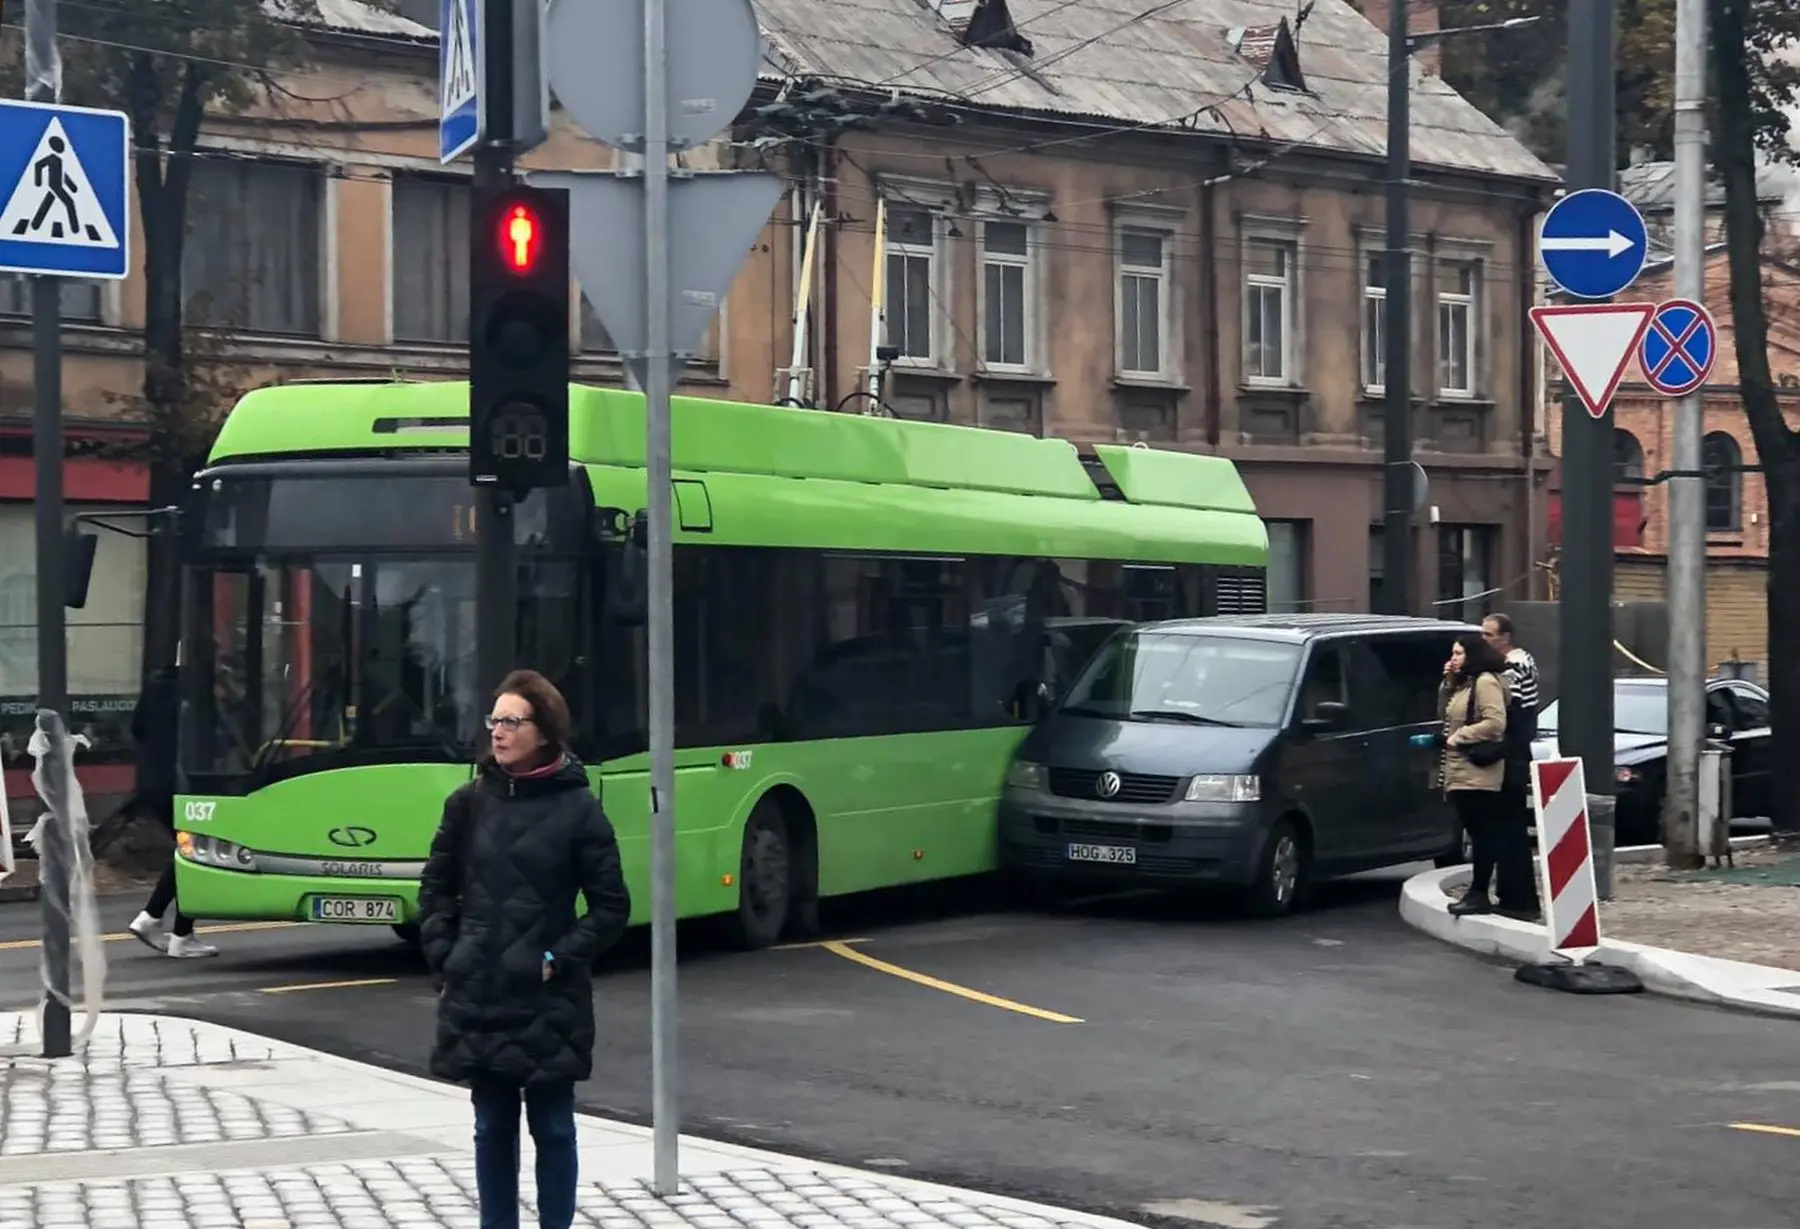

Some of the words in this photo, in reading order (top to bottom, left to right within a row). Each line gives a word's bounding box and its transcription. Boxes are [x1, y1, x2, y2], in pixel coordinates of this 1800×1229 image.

[71, 700, 137, 712] PASLAUGO
[185, 801, 216, 821] 037
[1071, 845, 1099, 859] HOG
[1108, 848, 1133, 862] 325
[320, 862, 383, 876] SOLARIS
[323, 900, 356, 917] COR
[366, 901, 394, 918] 874
